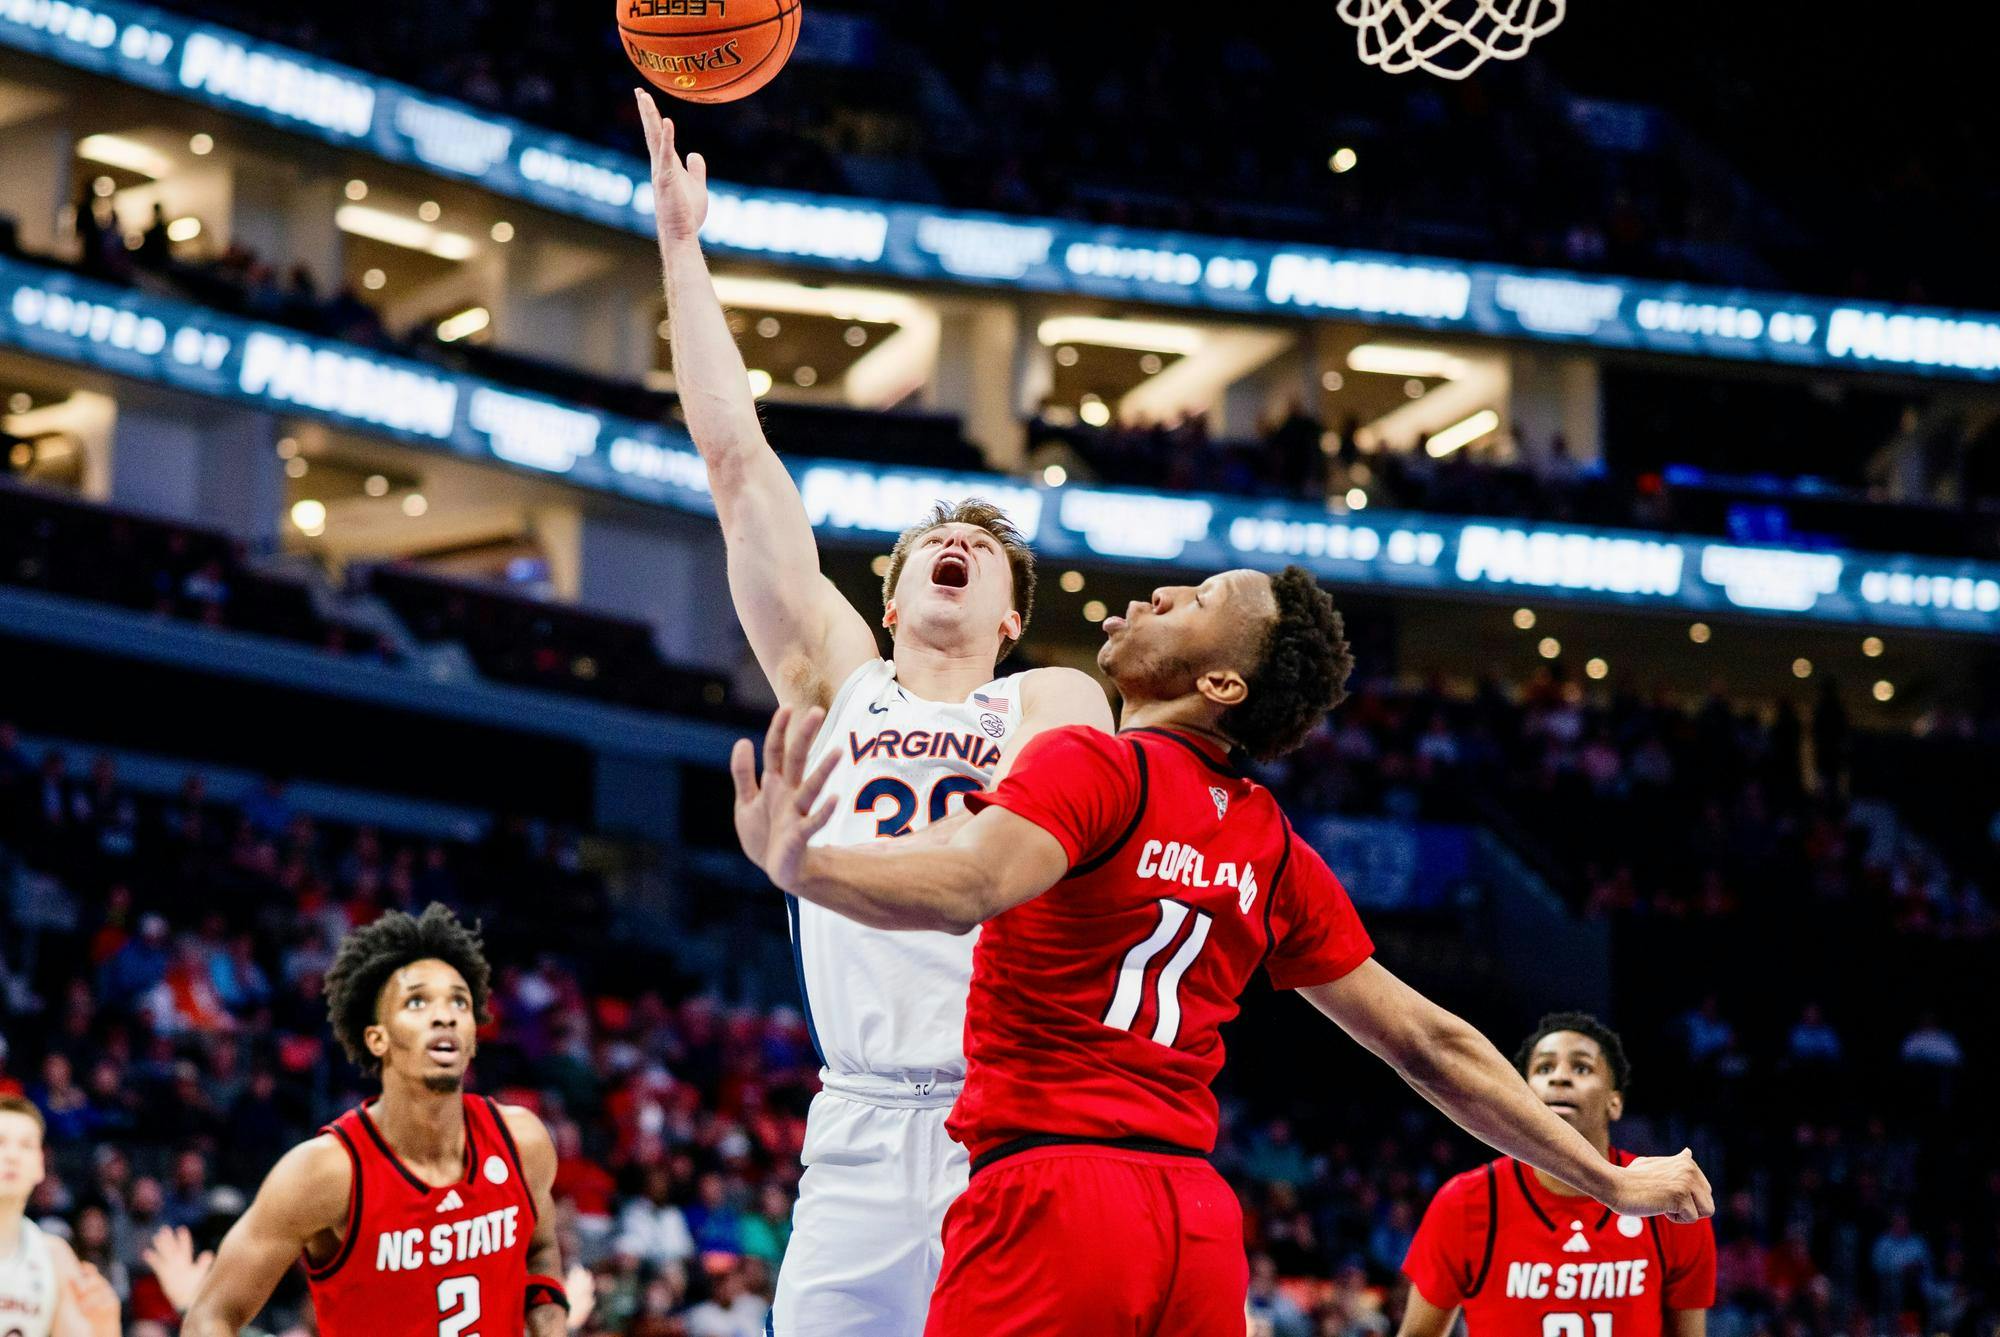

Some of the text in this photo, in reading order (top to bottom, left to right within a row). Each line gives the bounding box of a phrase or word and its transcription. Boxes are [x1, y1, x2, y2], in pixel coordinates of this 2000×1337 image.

[629, 0, 726, 17] LEGACY
[626, 38, 742, 72] SPALDING
[848, 729, 1002, 769] VRGINIA
[1100, 898, 1214, 1048] 11
[375, 1205, 520, 1272] NC STATE
[1506, 1258, 1649, 1300] NC STATE
[437, 1274, 481, 1337] 2
